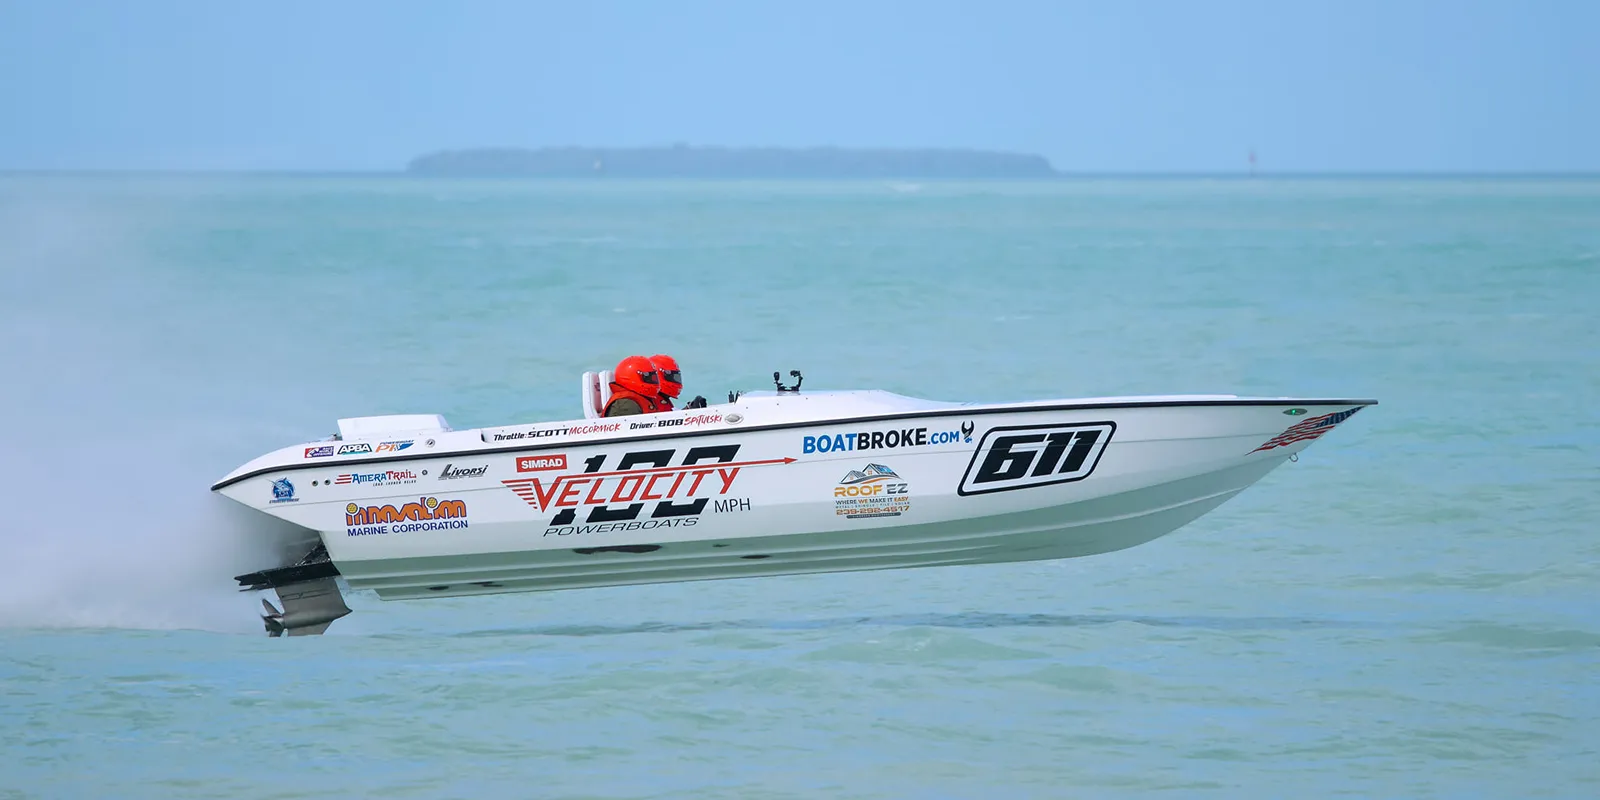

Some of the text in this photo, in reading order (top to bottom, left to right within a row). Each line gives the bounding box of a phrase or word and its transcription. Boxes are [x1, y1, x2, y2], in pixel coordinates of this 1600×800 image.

[629, 421, 657, 430] Driver:
[658, 419, 684, 428] BOB
[493, 432, 528, 441] Throttle:
[528, 428, 570, 439] SCOTT
[803, 428, 960, 454] BOATBROKE.COM
[339, 443, 371, 454] APBA
[521, 458, 563, 469] SIMRAD
[973, 430, 1102, 484] 611
[531, 466, 742, 513] VELOCITY
[834, 483, 908, 497] ROOF EZ
[714, 498, 751, 514] MPH
[347, 520, 468, 537] MARINE CORPORATION
[543, 517, 699, 537] POWERBOATS
